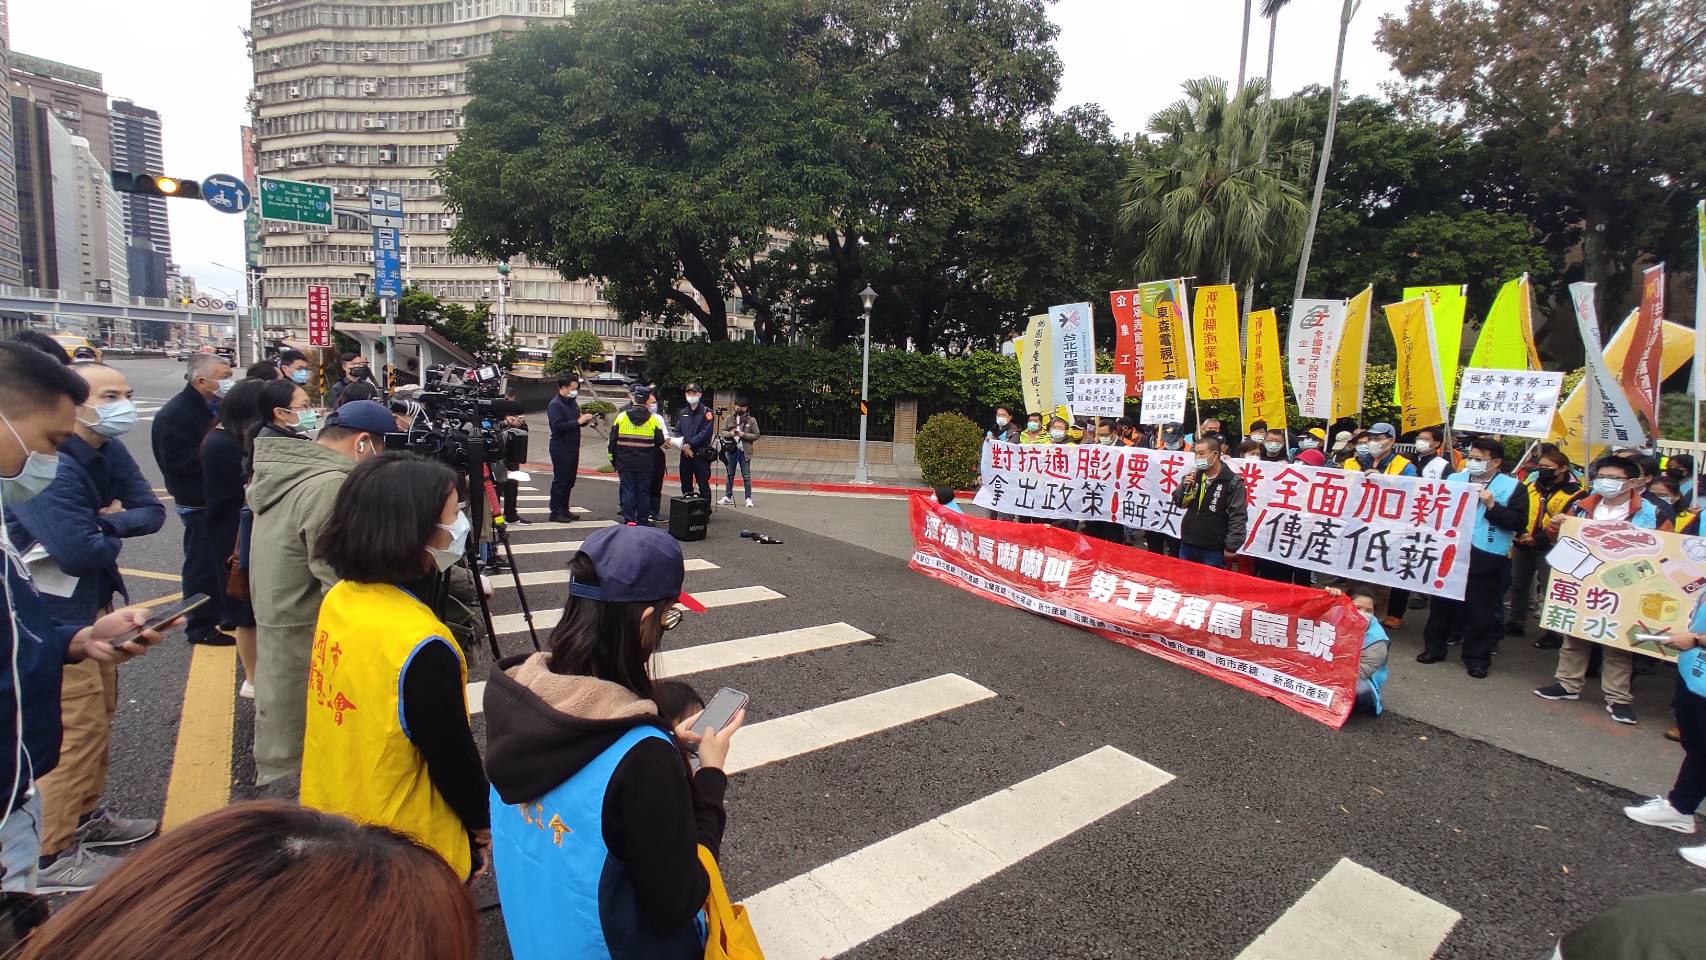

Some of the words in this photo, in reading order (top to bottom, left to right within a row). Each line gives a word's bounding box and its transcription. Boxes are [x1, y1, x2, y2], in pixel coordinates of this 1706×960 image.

[1304, 329, 1325, 415] 全國電子股份有限公司
[1549, 577, 1620, 615] 萬物
[1546, 604, 1620, 640] 薪水
